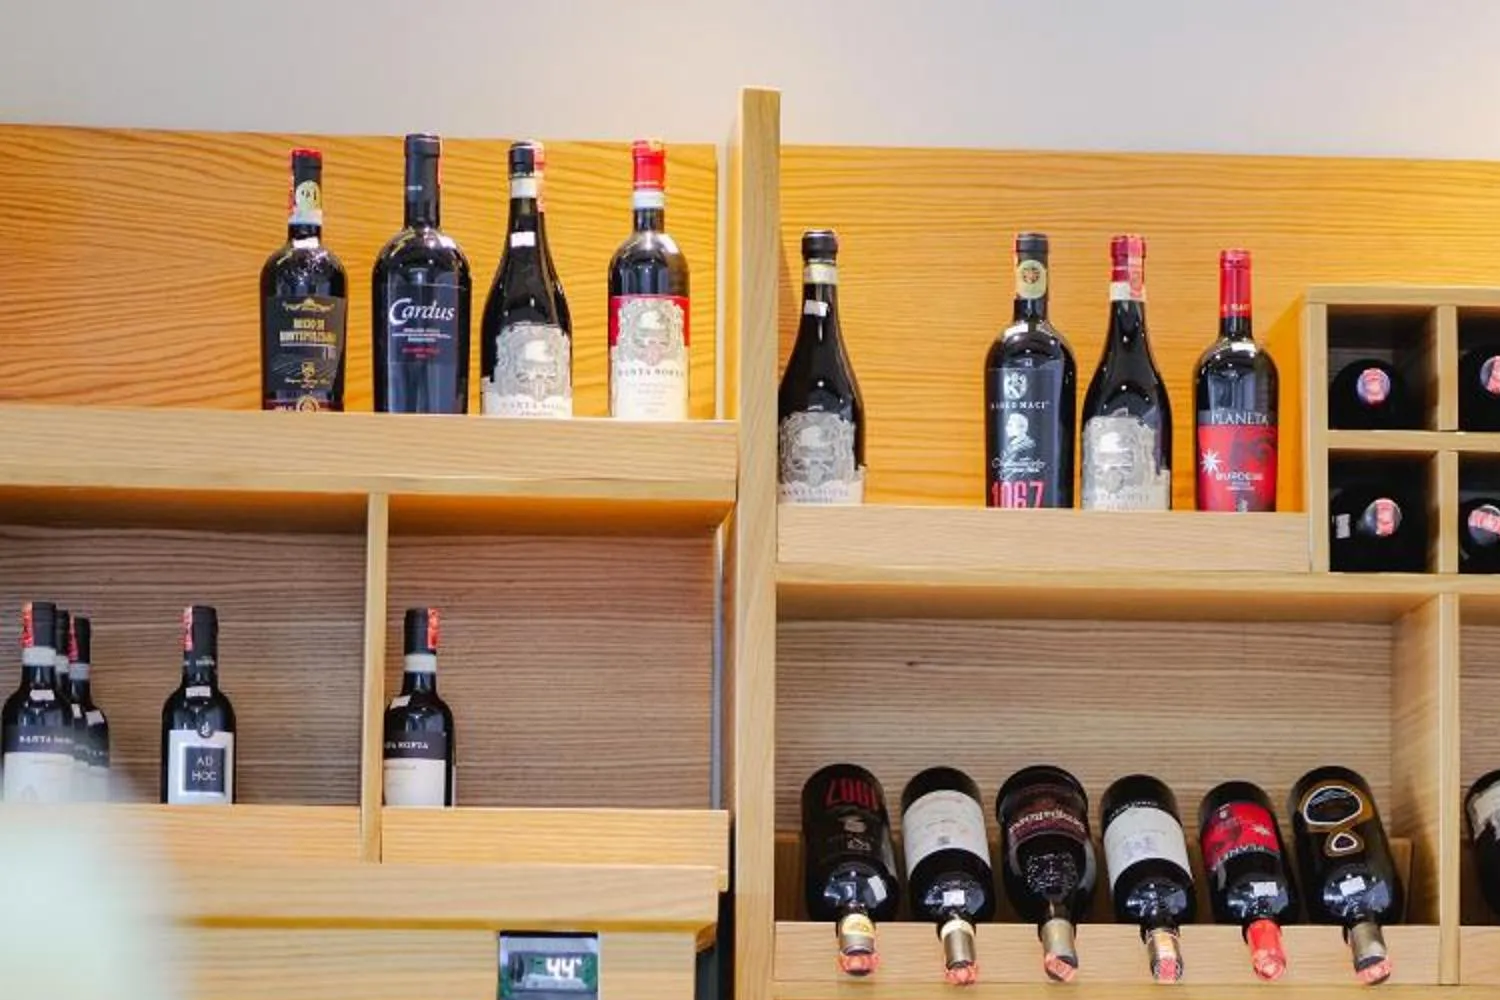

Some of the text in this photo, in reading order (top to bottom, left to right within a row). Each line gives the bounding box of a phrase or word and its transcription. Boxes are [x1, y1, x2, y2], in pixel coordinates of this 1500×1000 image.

[389, 297, 456, 325] Cardus
[1212, 408, 1269, 427] PLANETA
[196, 756, 213, 767] AD
[191, 771, 217, 783] HOC
